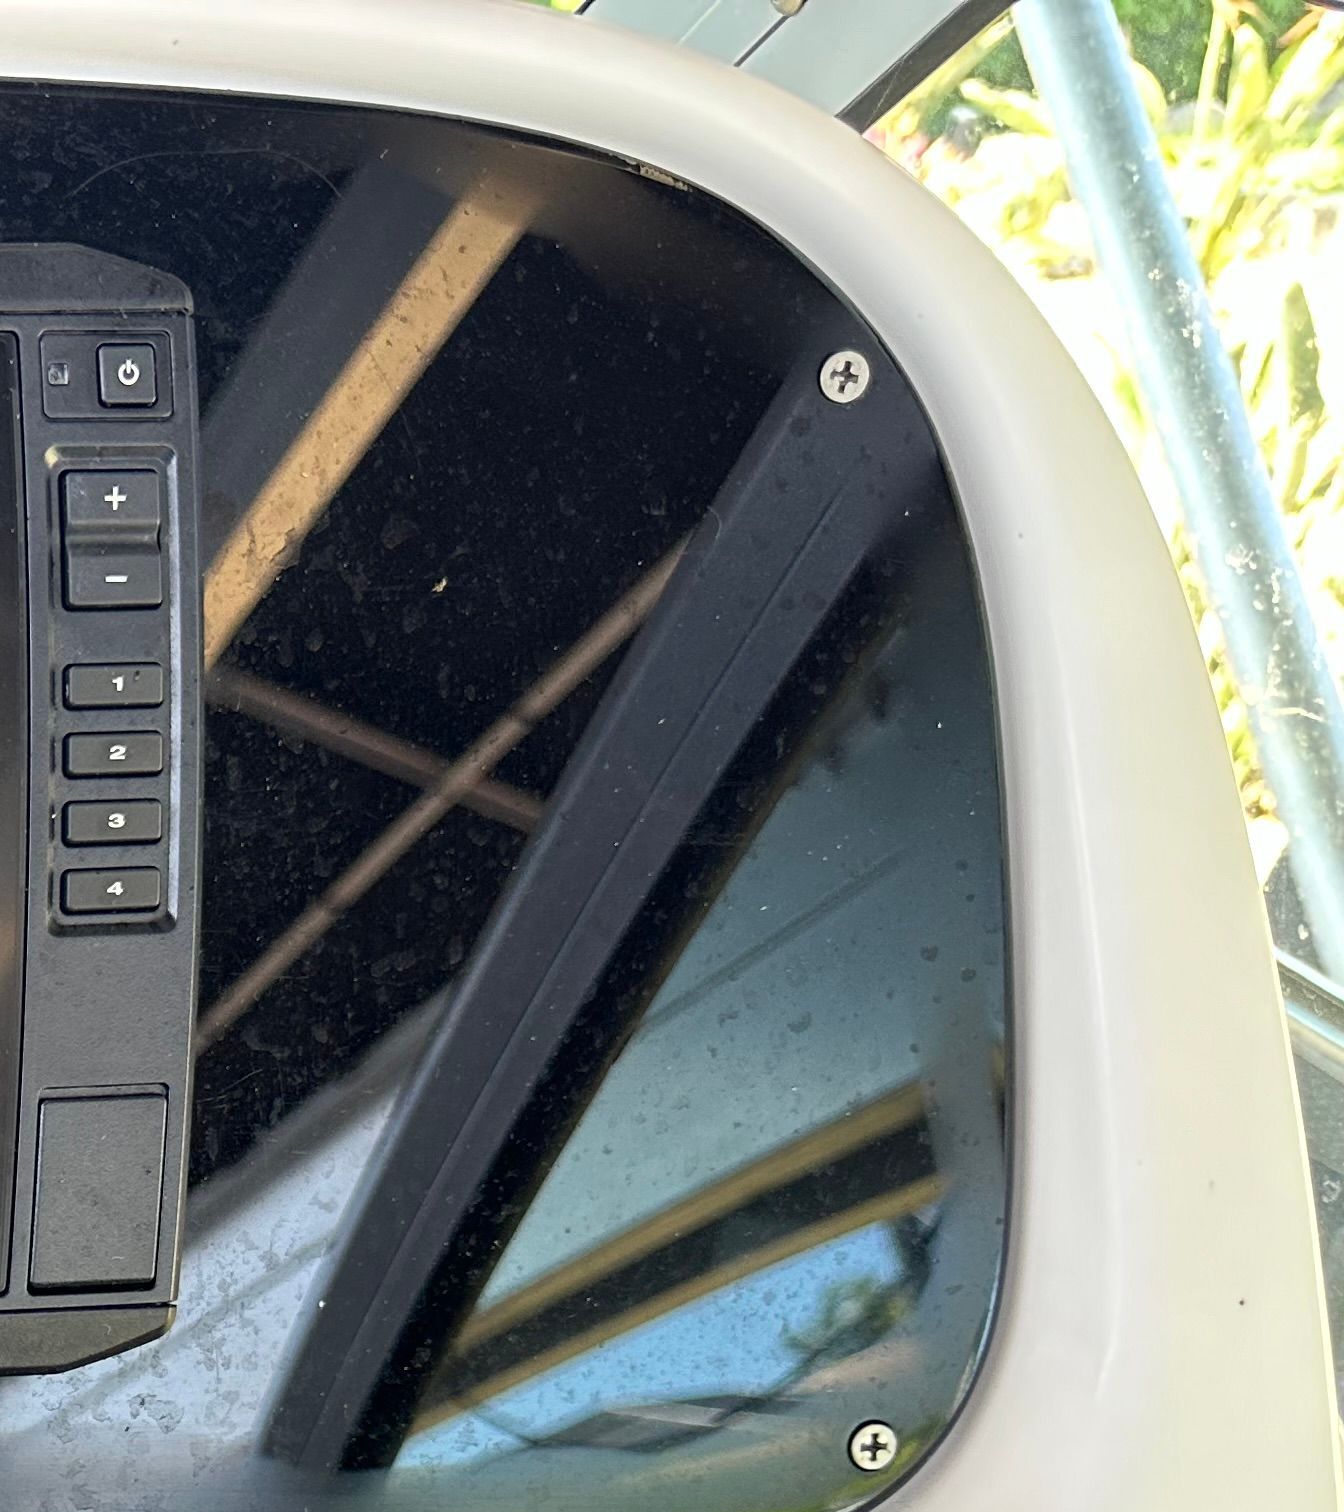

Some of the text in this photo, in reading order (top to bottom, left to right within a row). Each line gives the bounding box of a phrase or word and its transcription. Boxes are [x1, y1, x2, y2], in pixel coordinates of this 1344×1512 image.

[112, 676, 124, 692] 1
[109, 745, 126, 762] 2
[108, 813, 125, 829] 3
[106, 881, 124, 896] 4
